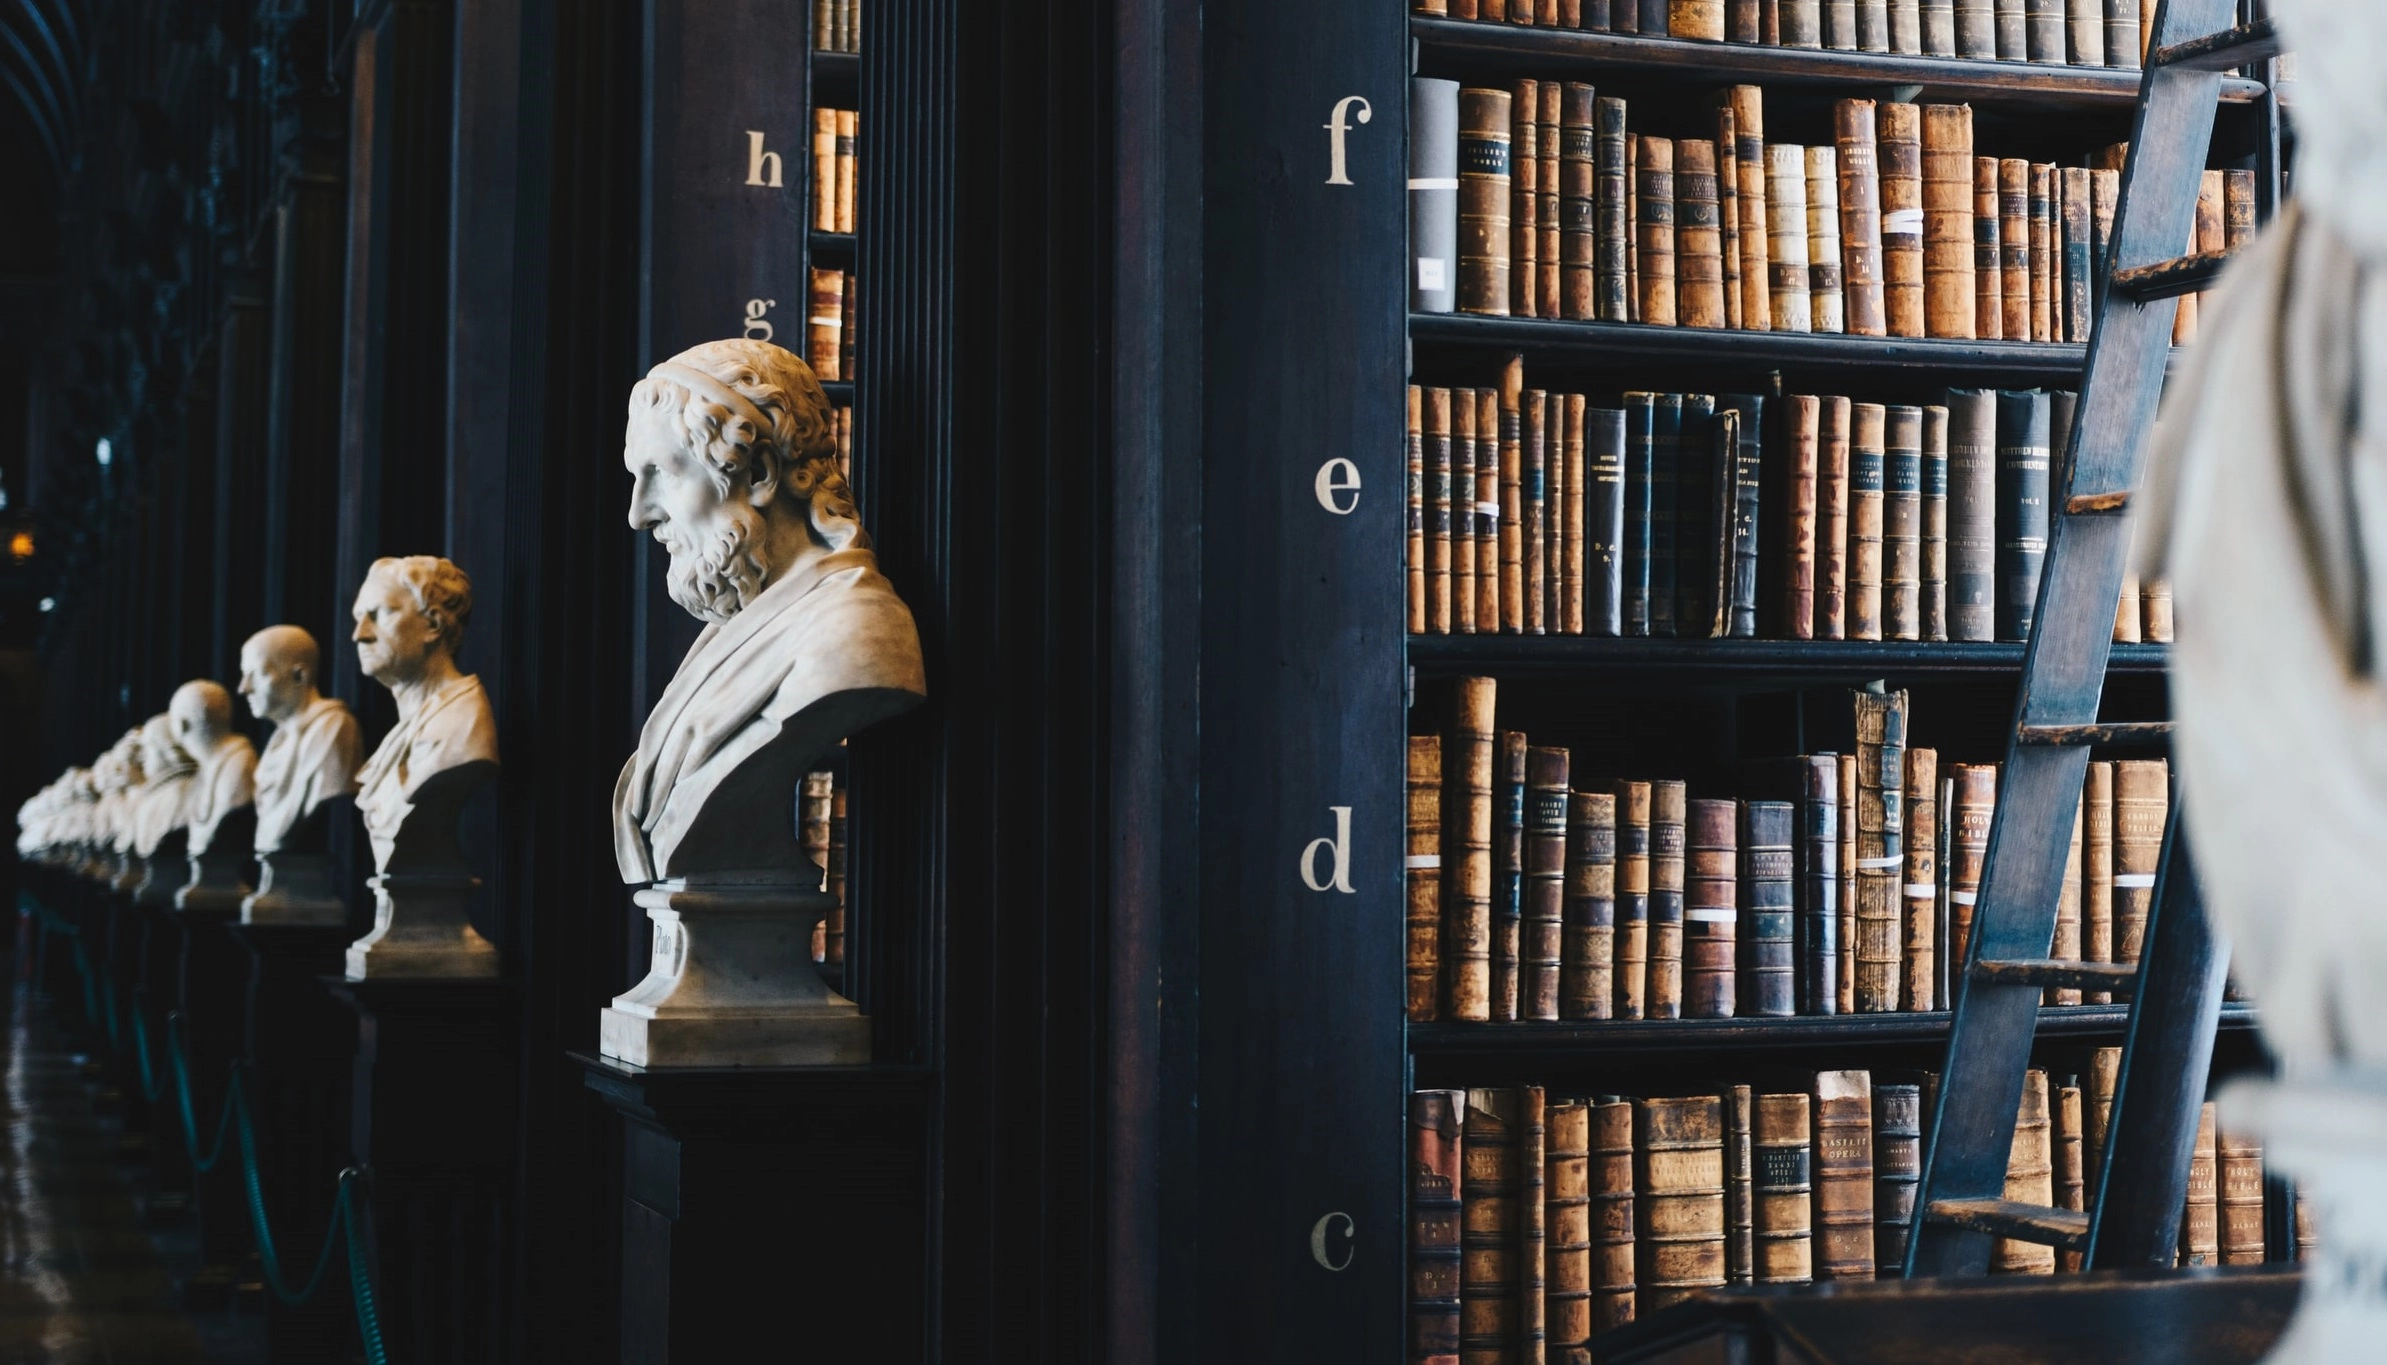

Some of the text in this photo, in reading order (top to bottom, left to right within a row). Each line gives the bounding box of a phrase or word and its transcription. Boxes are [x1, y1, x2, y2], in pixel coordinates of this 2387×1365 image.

[745, 131, 783, 188] h
[1323, 96, 1372, 186] f
[744, 298, 776, 342] g
[1315, 457, 1362, 515] e
[1300, 805, 1356, 894] d
[1829, 1150, 1861, 1158] OPERA
[2230, 1167, 2255, 1176] HOLY
[2228, 1181, 2259, 1191] BIBLE
[1310, 1211, 1355, 1272] c
